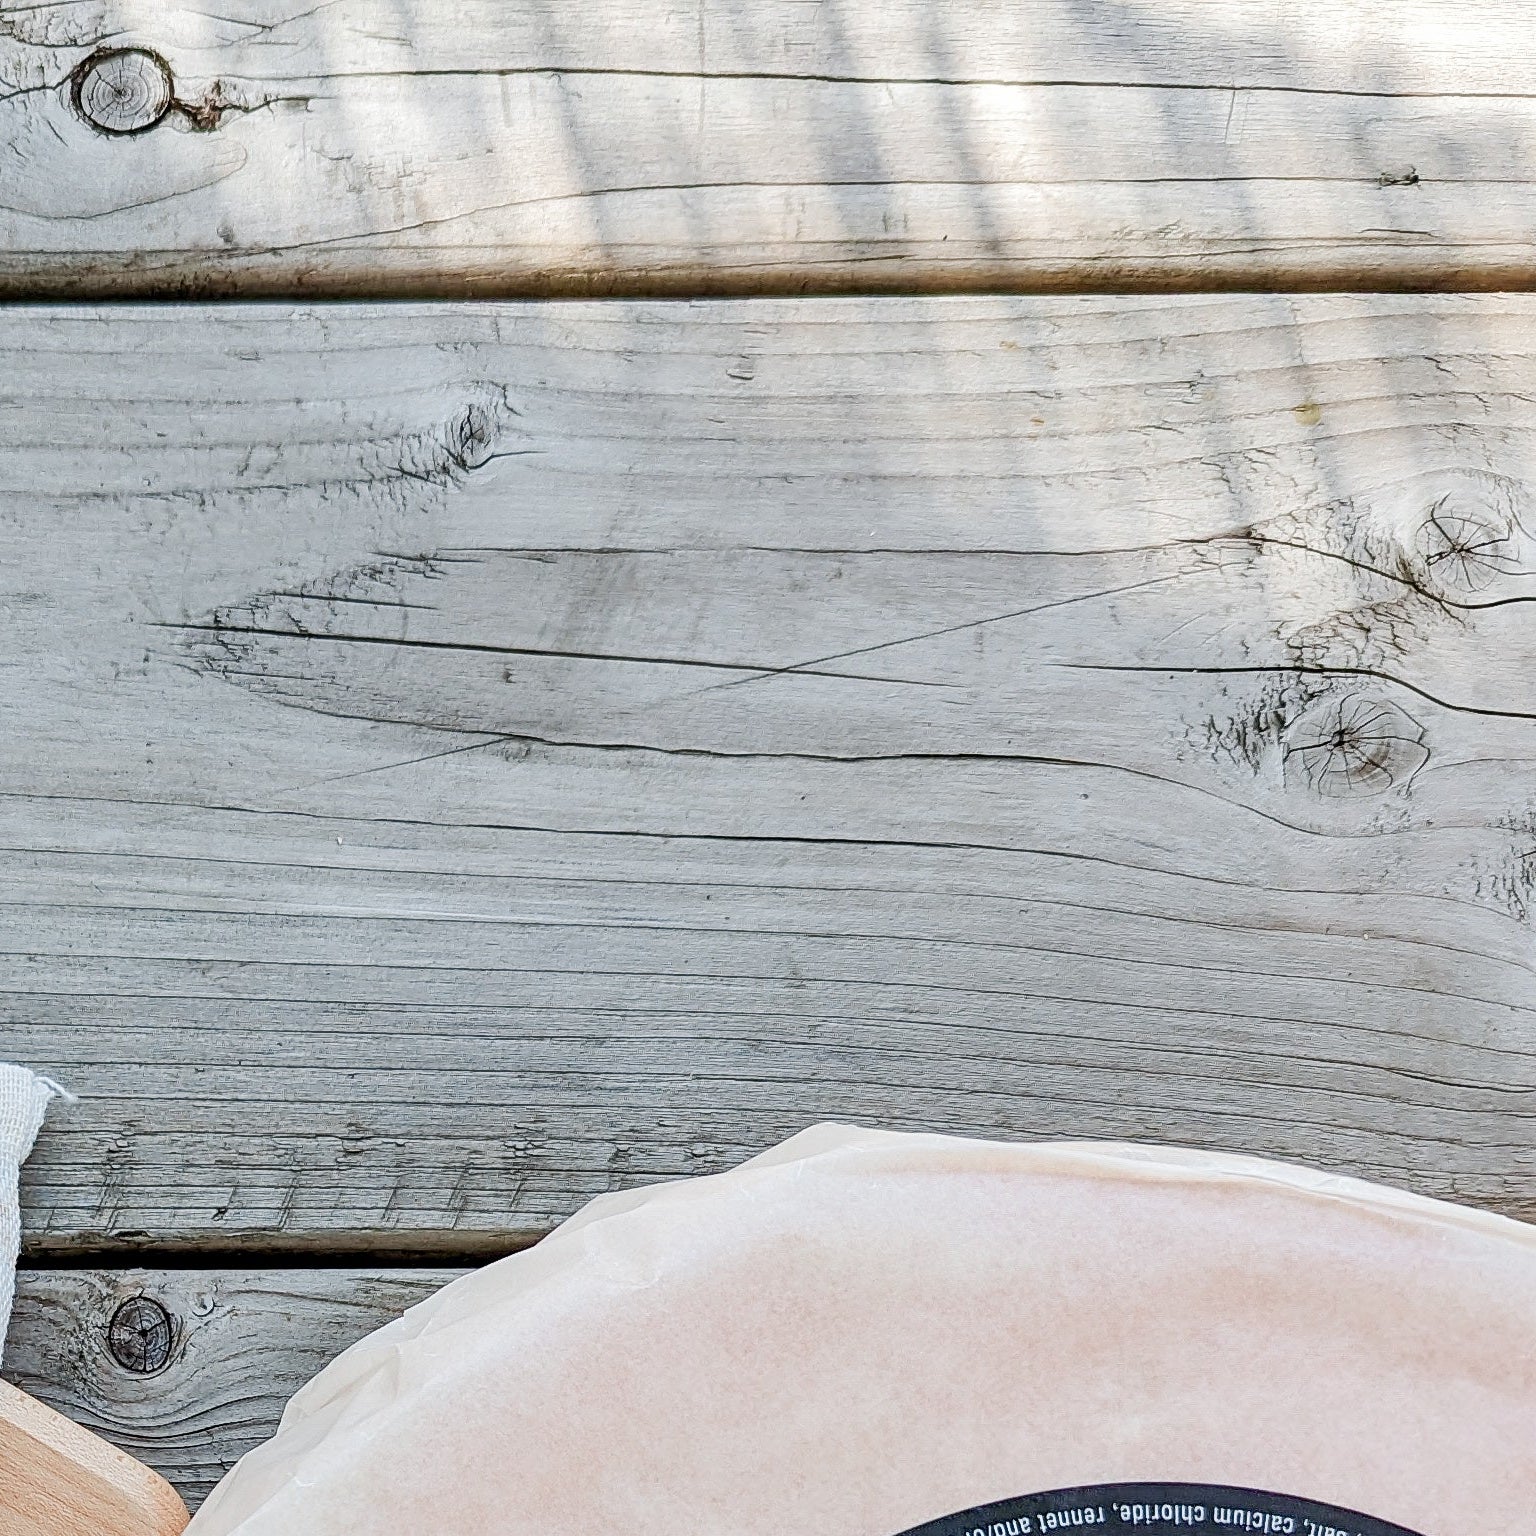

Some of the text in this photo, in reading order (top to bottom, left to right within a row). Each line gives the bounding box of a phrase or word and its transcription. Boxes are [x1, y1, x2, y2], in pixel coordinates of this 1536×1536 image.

[1039, 1506, 1105, 1533] rennet
[1112, 1502, 1205, 1524] chloride,
[1214, 1507, 1294, 1534] calcium
